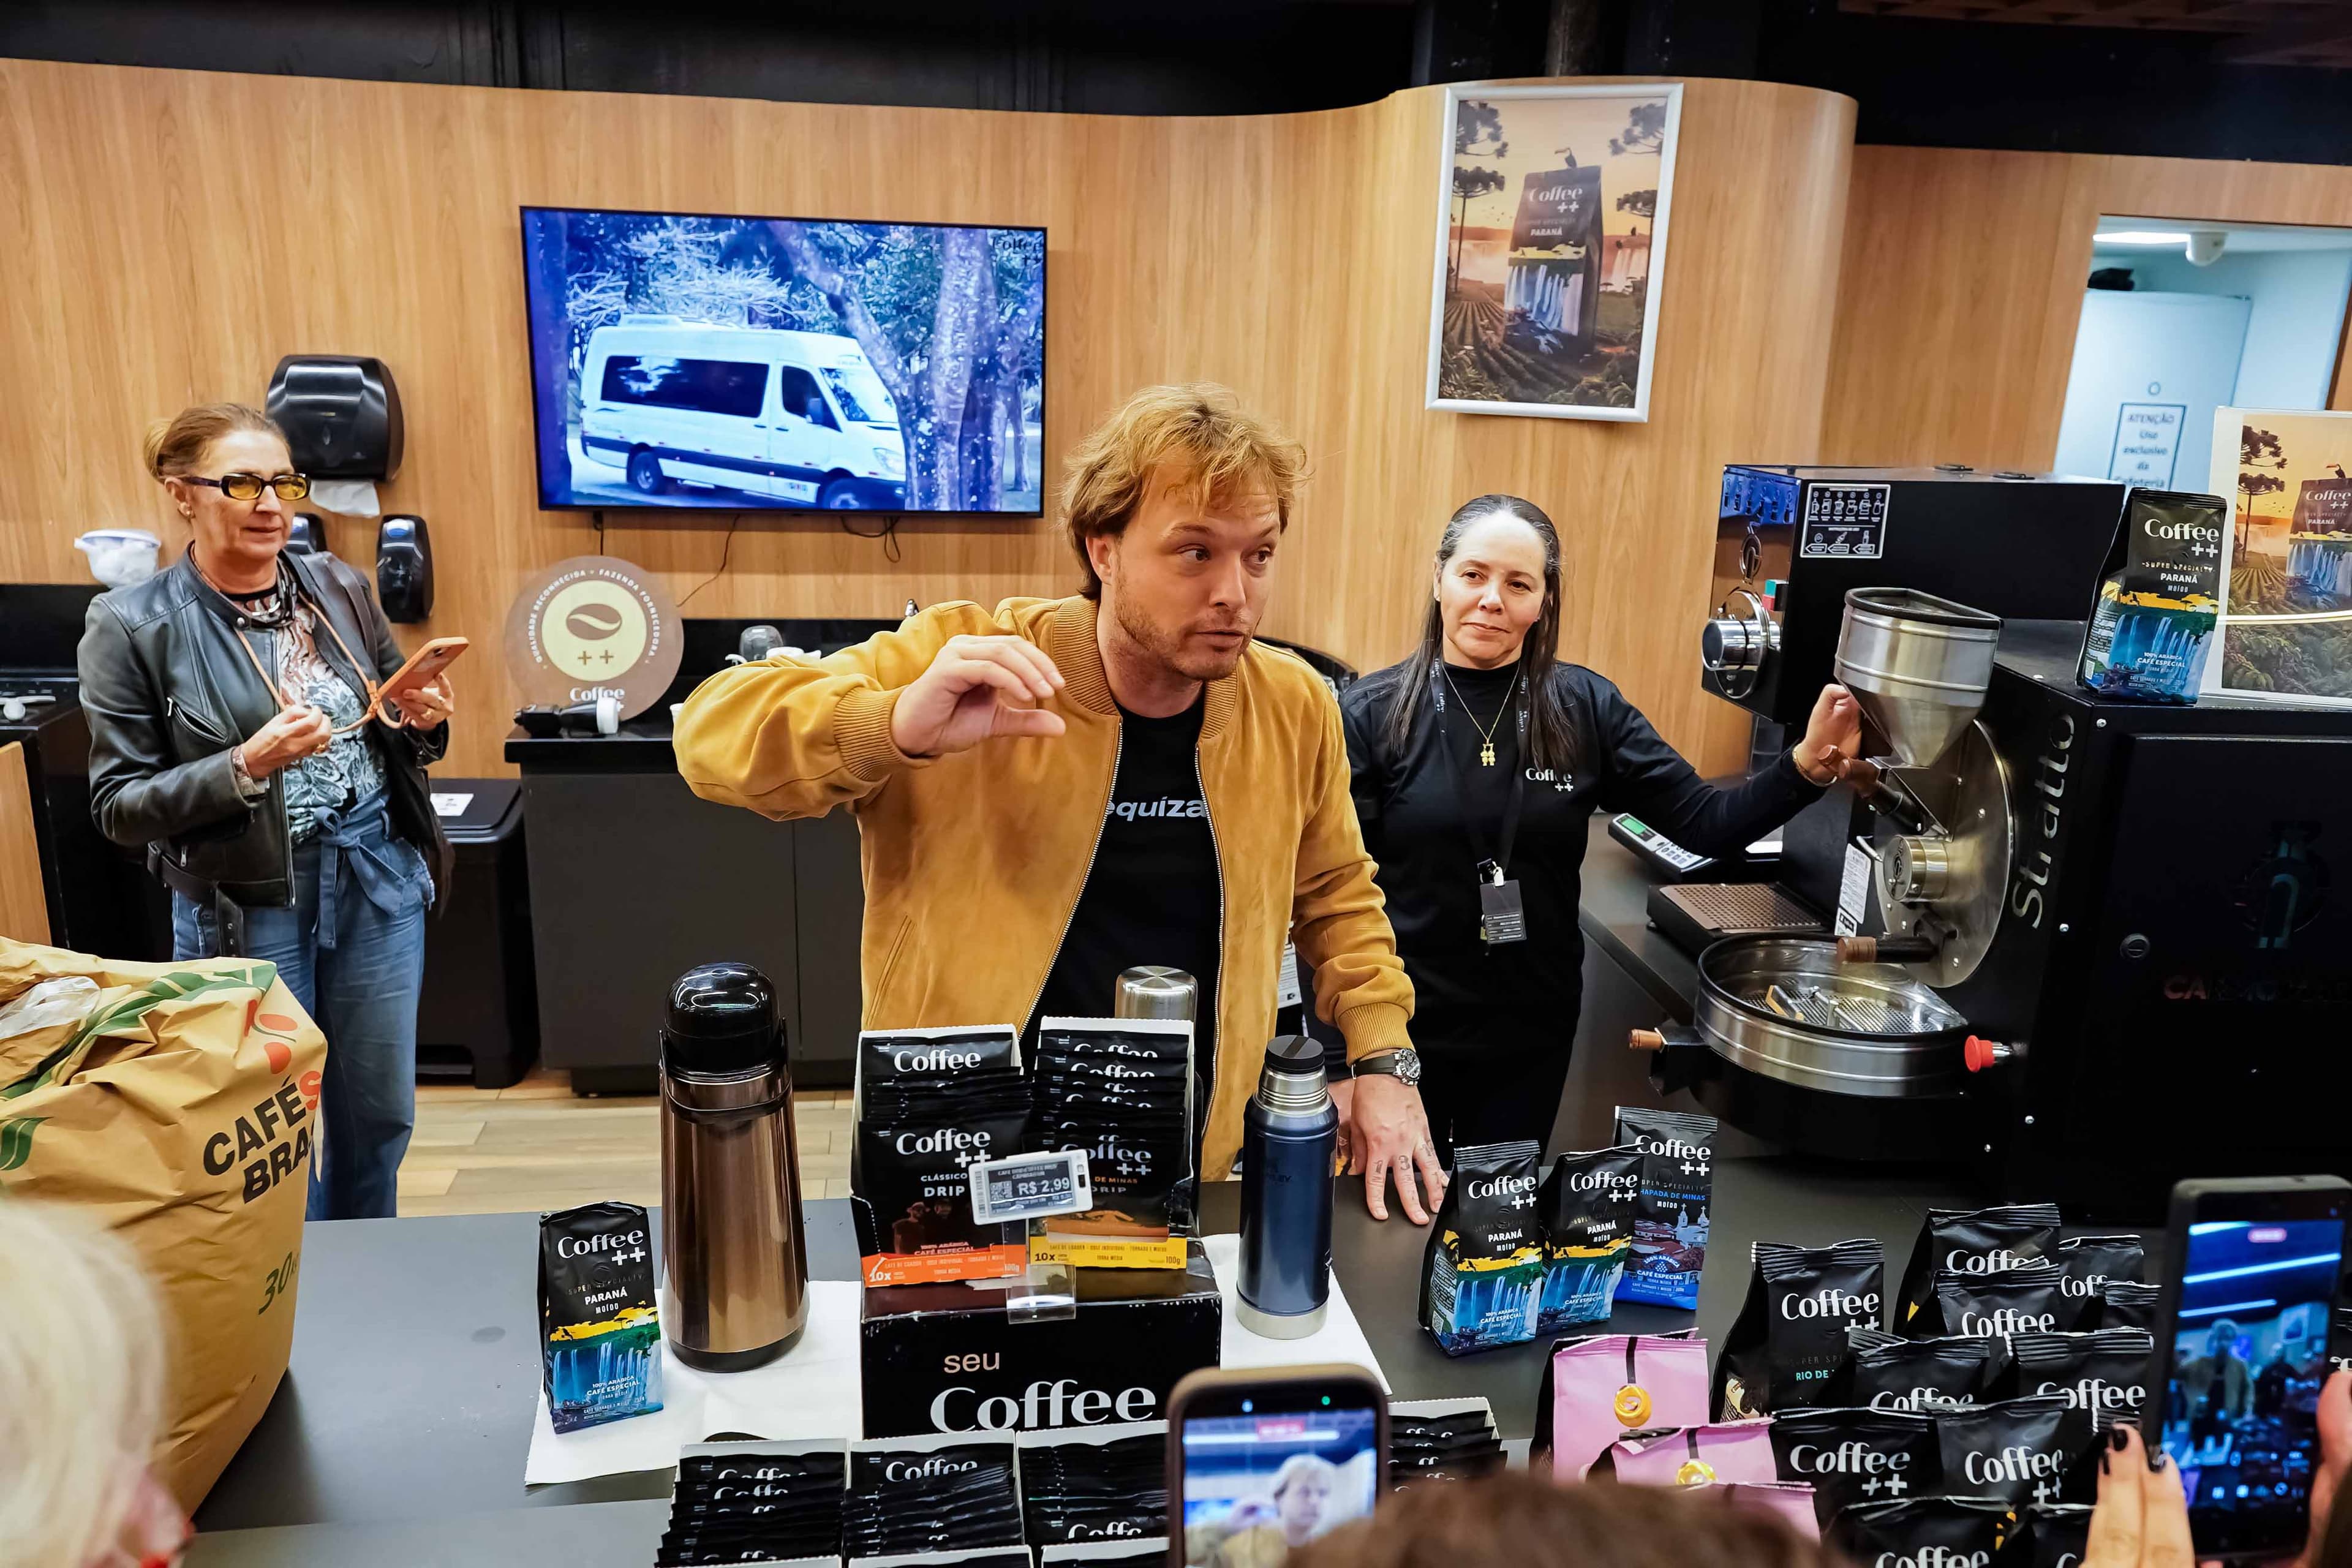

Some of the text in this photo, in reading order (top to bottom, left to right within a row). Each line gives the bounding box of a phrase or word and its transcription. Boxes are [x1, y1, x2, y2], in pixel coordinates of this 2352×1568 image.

[1529, 186, 1583, 202] Coffee
[2305, 490, 2351, 500] Coffee
[2144, 519, 2220, 542] Coffee
[598, 568, 639, 591] FAZENDA
[2160, 573, 2198, 584] PARANÁ
[528, 613, 543, 663] QUALIDADE
[2155, 659, 2185, 668] ESPECIAL
[570, 687, 625, 702] Coffee
[894, 1049, 981, 1072] Coffee
[895, 1128, 991, 1155] Coffee
[1635, 1135, 1711, 1161] Coffee
[921, 1172, 968, 1182] CLÁSSICO
[1570, 1171, 1638, 1192] Coffee
[924, 1186, 965, 1197] DRIP
[1018, 1180, 1038, 1196] R$
[1468, 1175, 1536, 1199] Coffee
[1488, 1228, 1523, 1243] PARANÁ
[1587, 1220, 1617, 1235] PARANÁ
[557, 1230, 644, 1259] Coffee
[937, 1246, 975, 1255] ESPECIAL
[1496, 1243, 1515, 1251] MOÍDO
[1035, 1253, 1055, 1262] 10x
[1166, 1256, 1181, 1265] 100g
[584, 1286, 628, 1305] PARANÁ
[595, 1303, 619, 1314] MOÍDO
[1781, 1289, 1879, 1320] Coffee
[1496, 1313, 1521, 1322] ESPECIAL
[1961, 1308, 2056, 1338] Coffee
[943, 1352, 1000, 1373] seu
[608, 1375, 635, 1385] ARÁBICA
[1796, 1371, 1812, 1381] RIO
[587, 1380, 641, 1396] CAFÉ ESPECIAL
[930, 1379, 1156, 1433] Coffee
[1789, 1441, 1910, 1474] Coffee
[1964, 1446, 2064, 1485] Coffee
